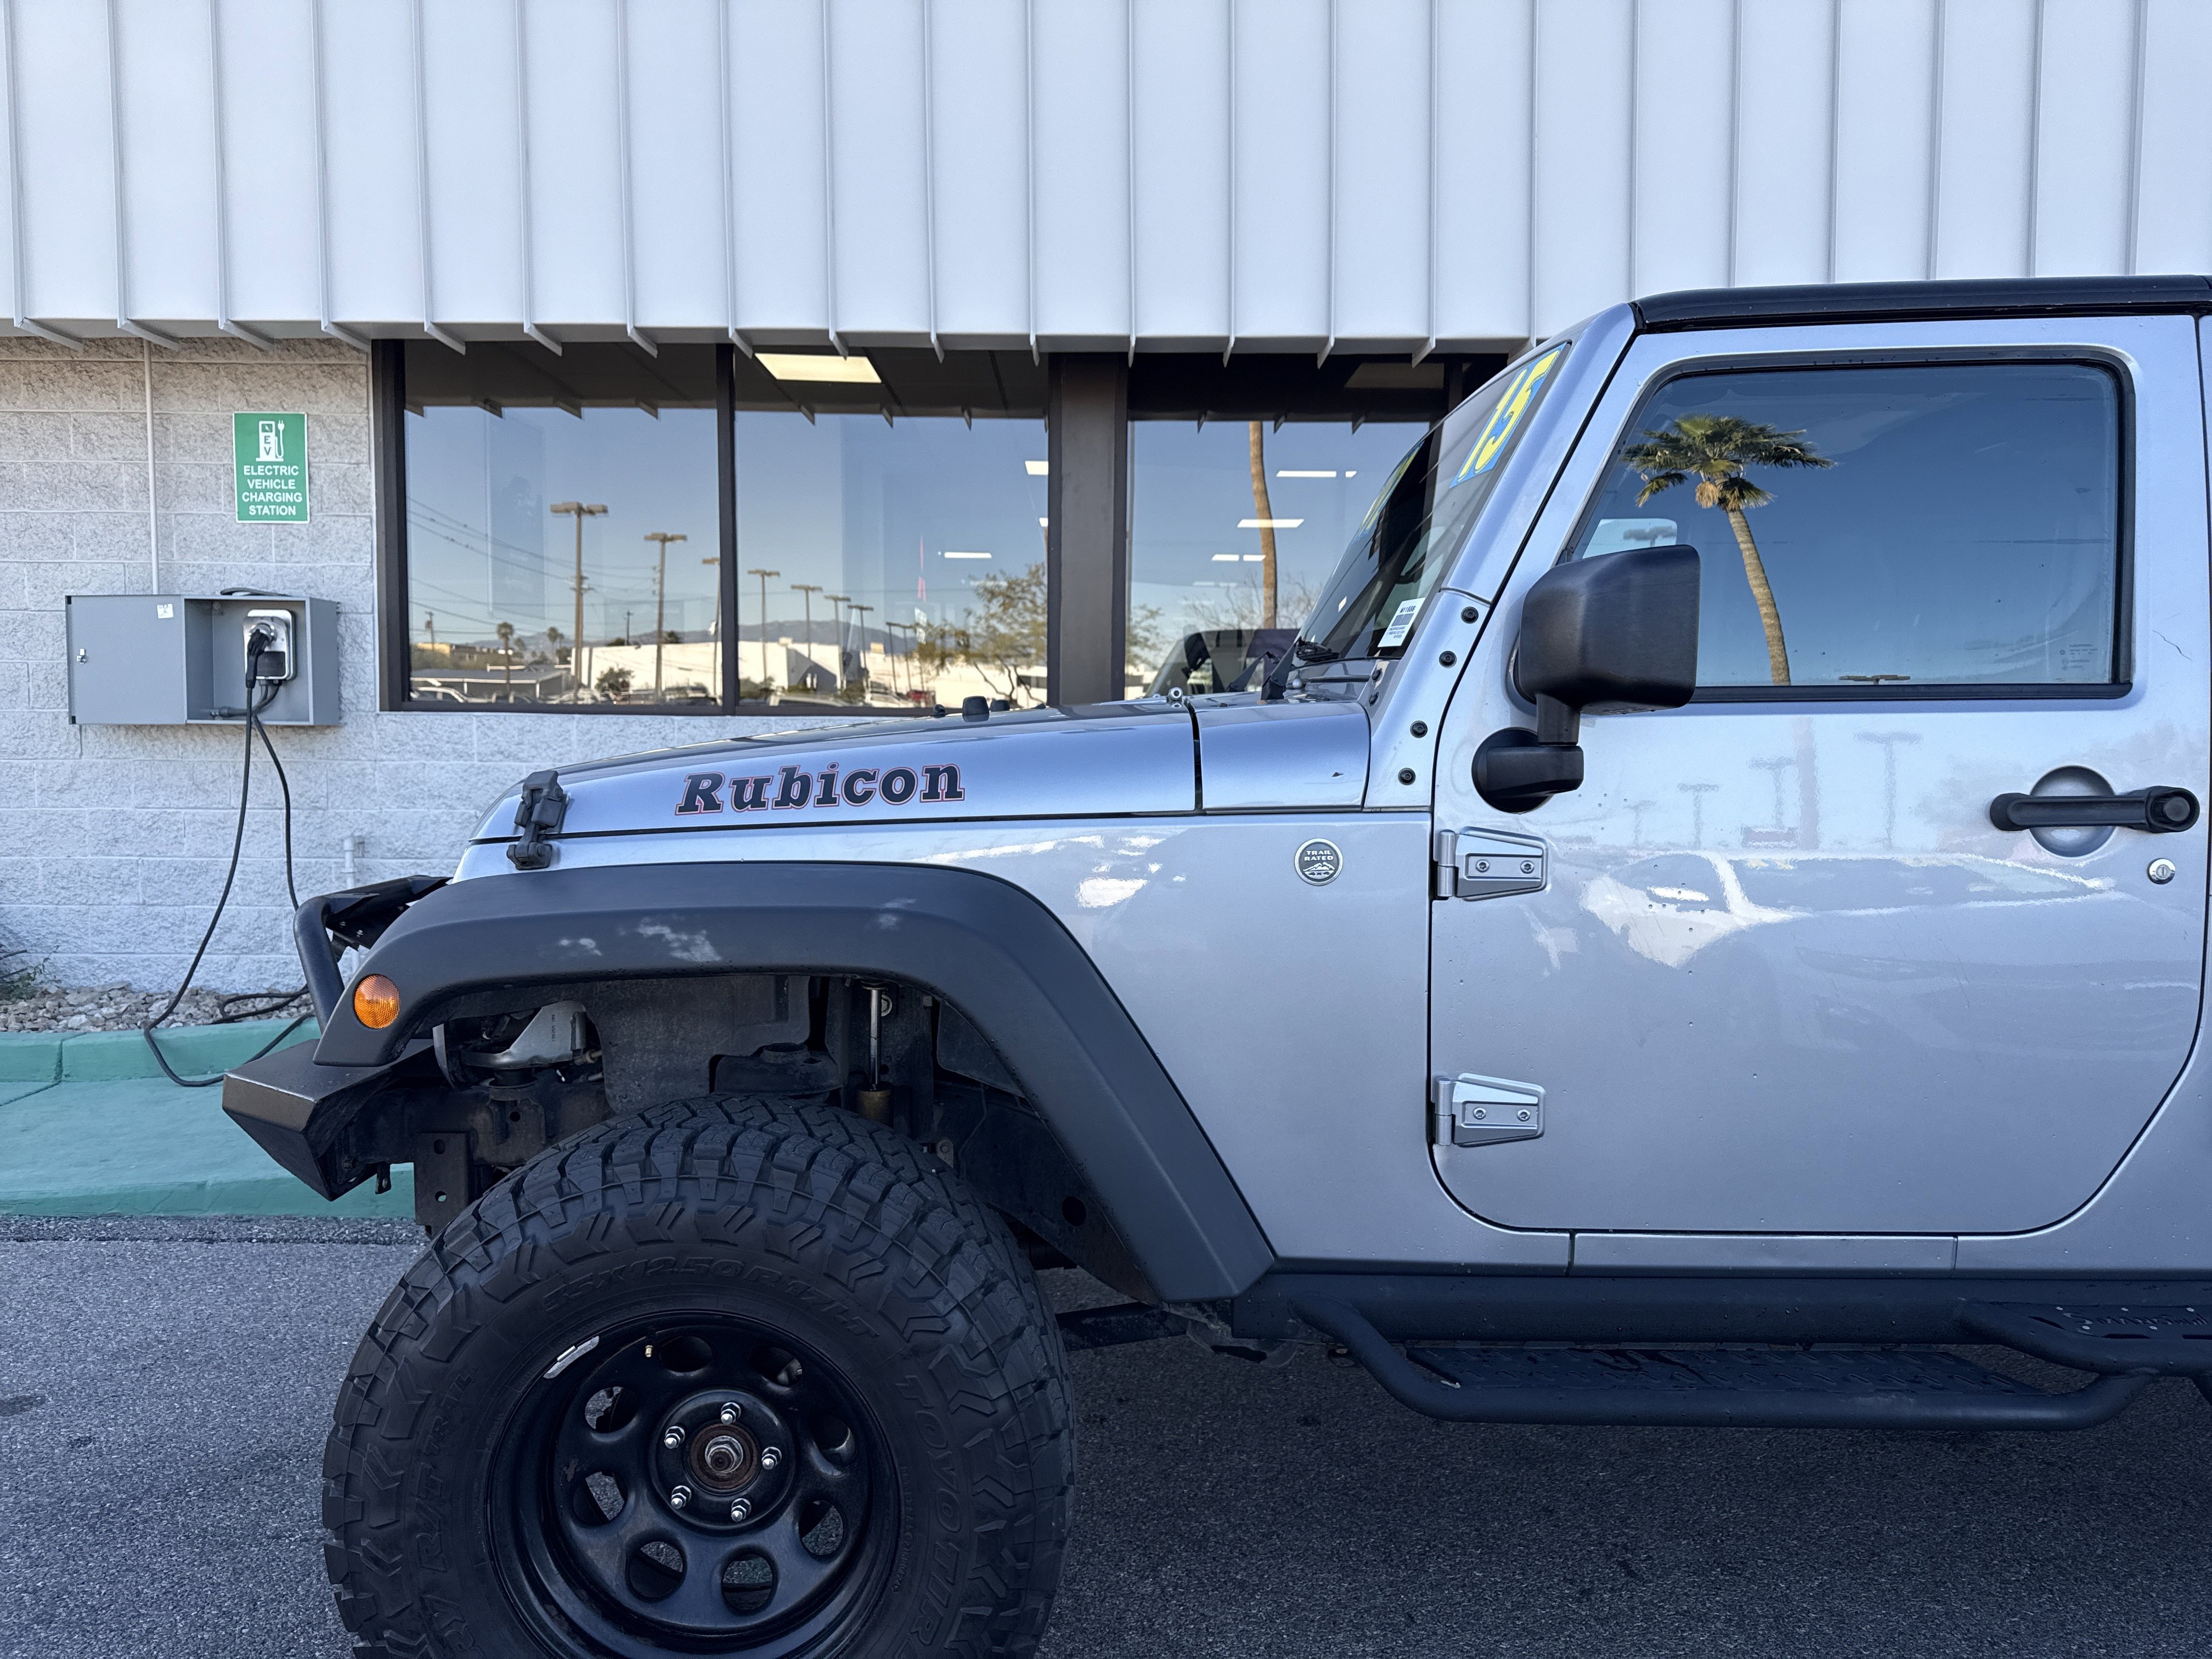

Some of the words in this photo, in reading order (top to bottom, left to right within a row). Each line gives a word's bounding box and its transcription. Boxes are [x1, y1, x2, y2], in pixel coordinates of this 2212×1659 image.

[1457, 349, 1560, 483] 15
[264, 435, 271, 456] EV
[244, 465, 299, 476] ELECTRIC
[247, 479, 296, 489] VEHICLE
[242, 492, 302, 502] CHARGING
[249, 505, 296, 515] STATION
[675, 762, 966, 816] Rubicon
[895, 1374, 961, 1533] TOYO
